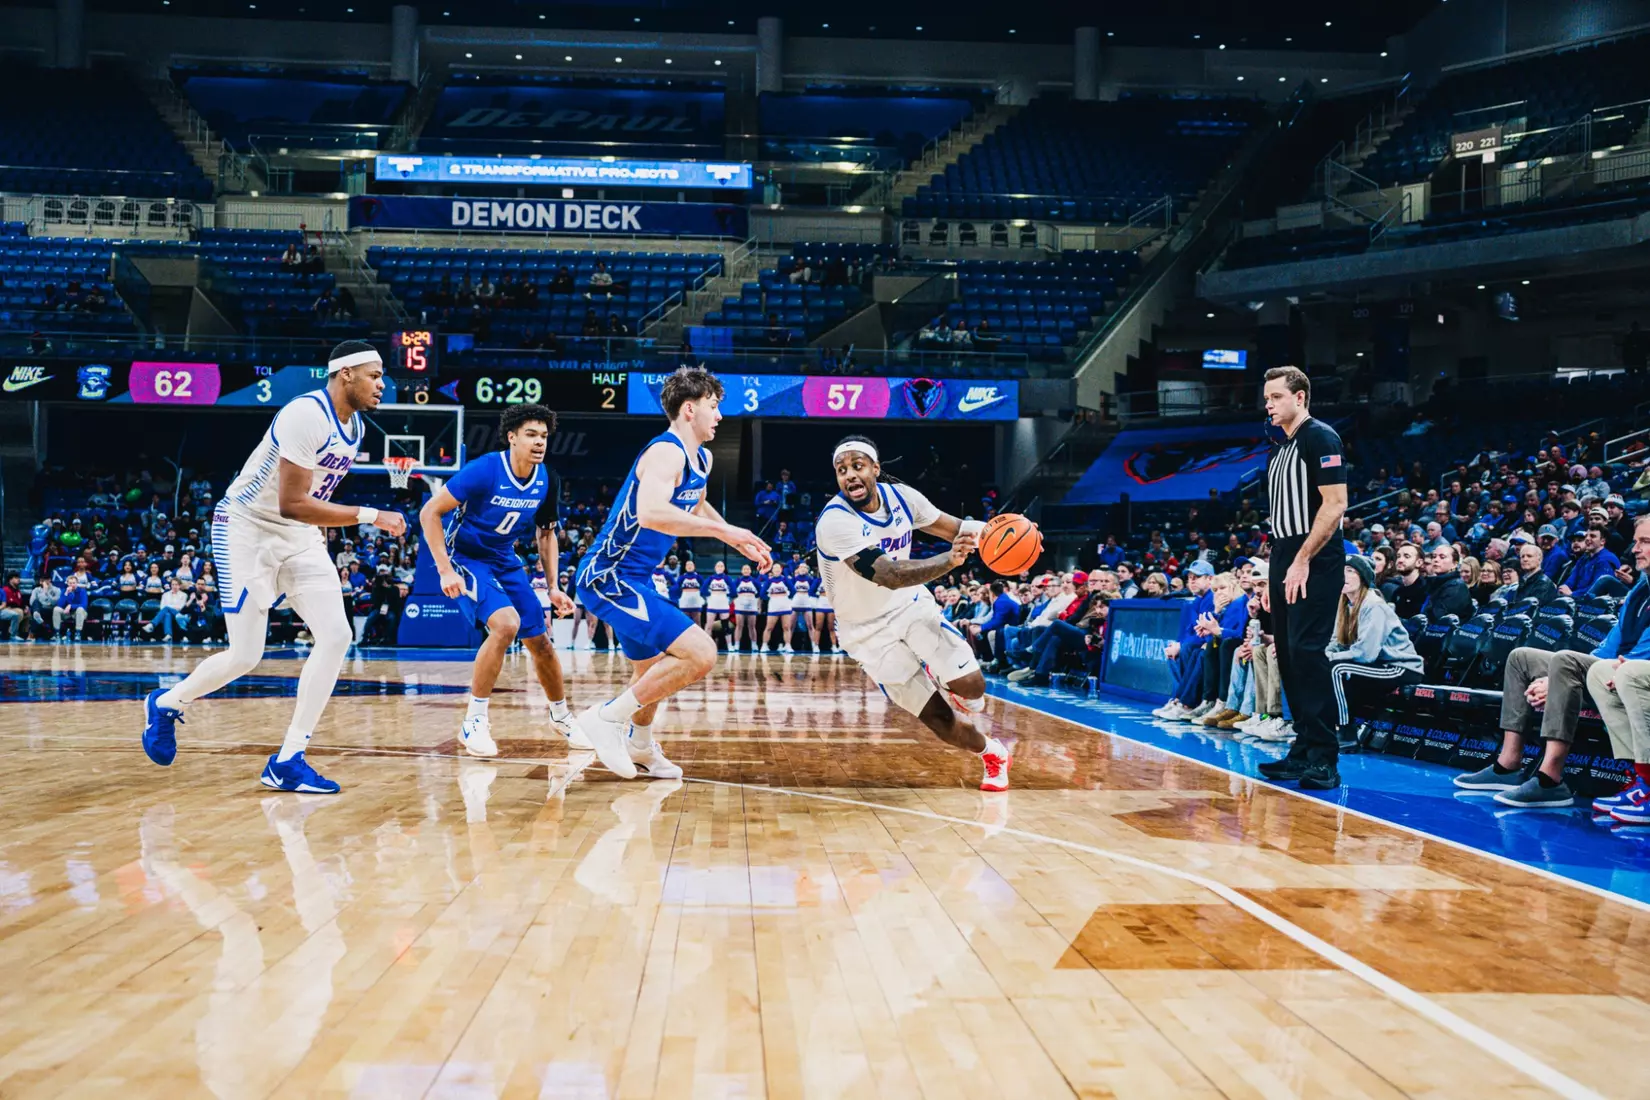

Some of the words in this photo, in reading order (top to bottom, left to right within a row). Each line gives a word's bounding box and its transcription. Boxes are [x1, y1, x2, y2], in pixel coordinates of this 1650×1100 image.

[1456, 141, 1474, 151] 220
[1480, 137, 1496, 148] 221
[599, 167, 680, 180] PROJECTS
[451, 201, 556, 229] DEMON
[563, 204, 643, 231] DECK
[402, 331, 431, 346] 6:29
[406, 346, 427, 370] 15
[11, 366, 45, 379] NIKE
[253, 366, 274, 377] TOL
[154, 370, 192, 397] 62
[592, 372, 627, 386] HALF
[642, 374, 665, 384] TEA
[741, 375, 761, 387] TOL
[256, 379, 272, 403] 3
[475, 377, 542, 404] 6:29
[827, 384, 863, 411] 57
[967, 387, 999, 401] NIKE
[601, 387, 616, 409] 2
[743, 389, 759, 411] 3
[490, 495, 541, 509] CREIGHTON
[494, 511, 521, 535] 0
[1597, 771, 1626, 783] AVIATION
